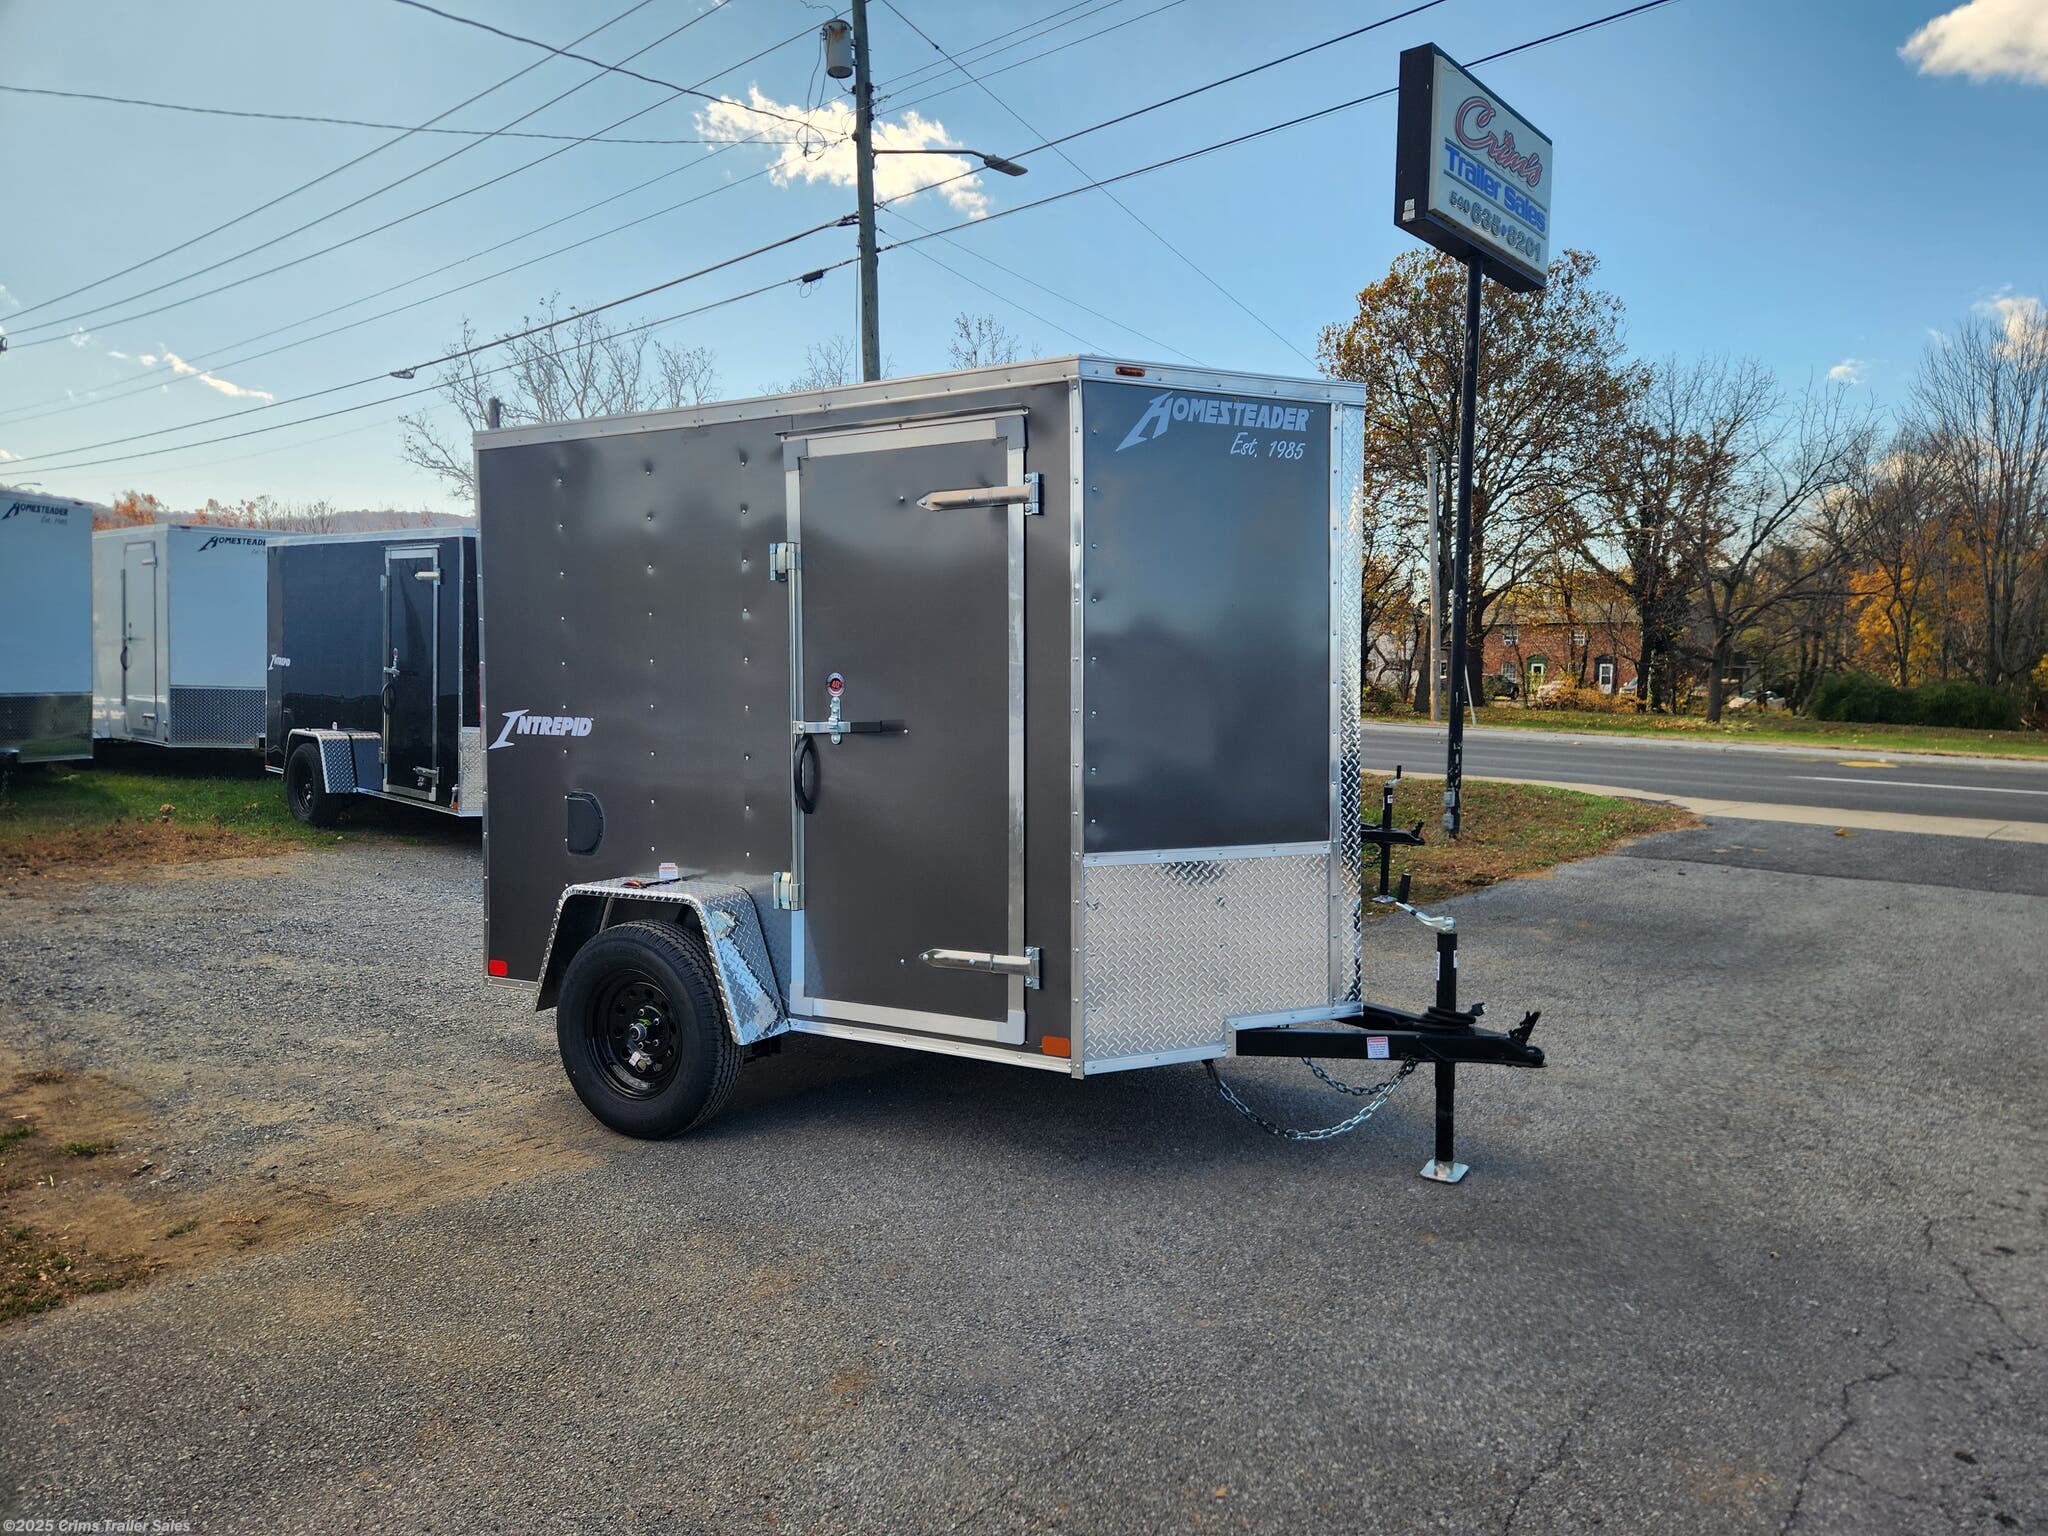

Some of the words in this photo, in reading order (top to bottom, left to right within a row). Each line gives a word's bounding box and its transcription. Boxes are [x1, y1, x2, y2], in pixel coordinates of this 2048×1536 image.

[1456, 97, 1542, 186] Crim's
[1445, 143, 1501, 201] Trailer
[1503, 185, 1546, 233] Sales
[1116, 391, 1310, 451] HOMESTEADER
[1230, 432, 1258, 458] Est.
[1269, 440, 1306, 460] 1985
[488, 709, 592, 750] INTREPID
